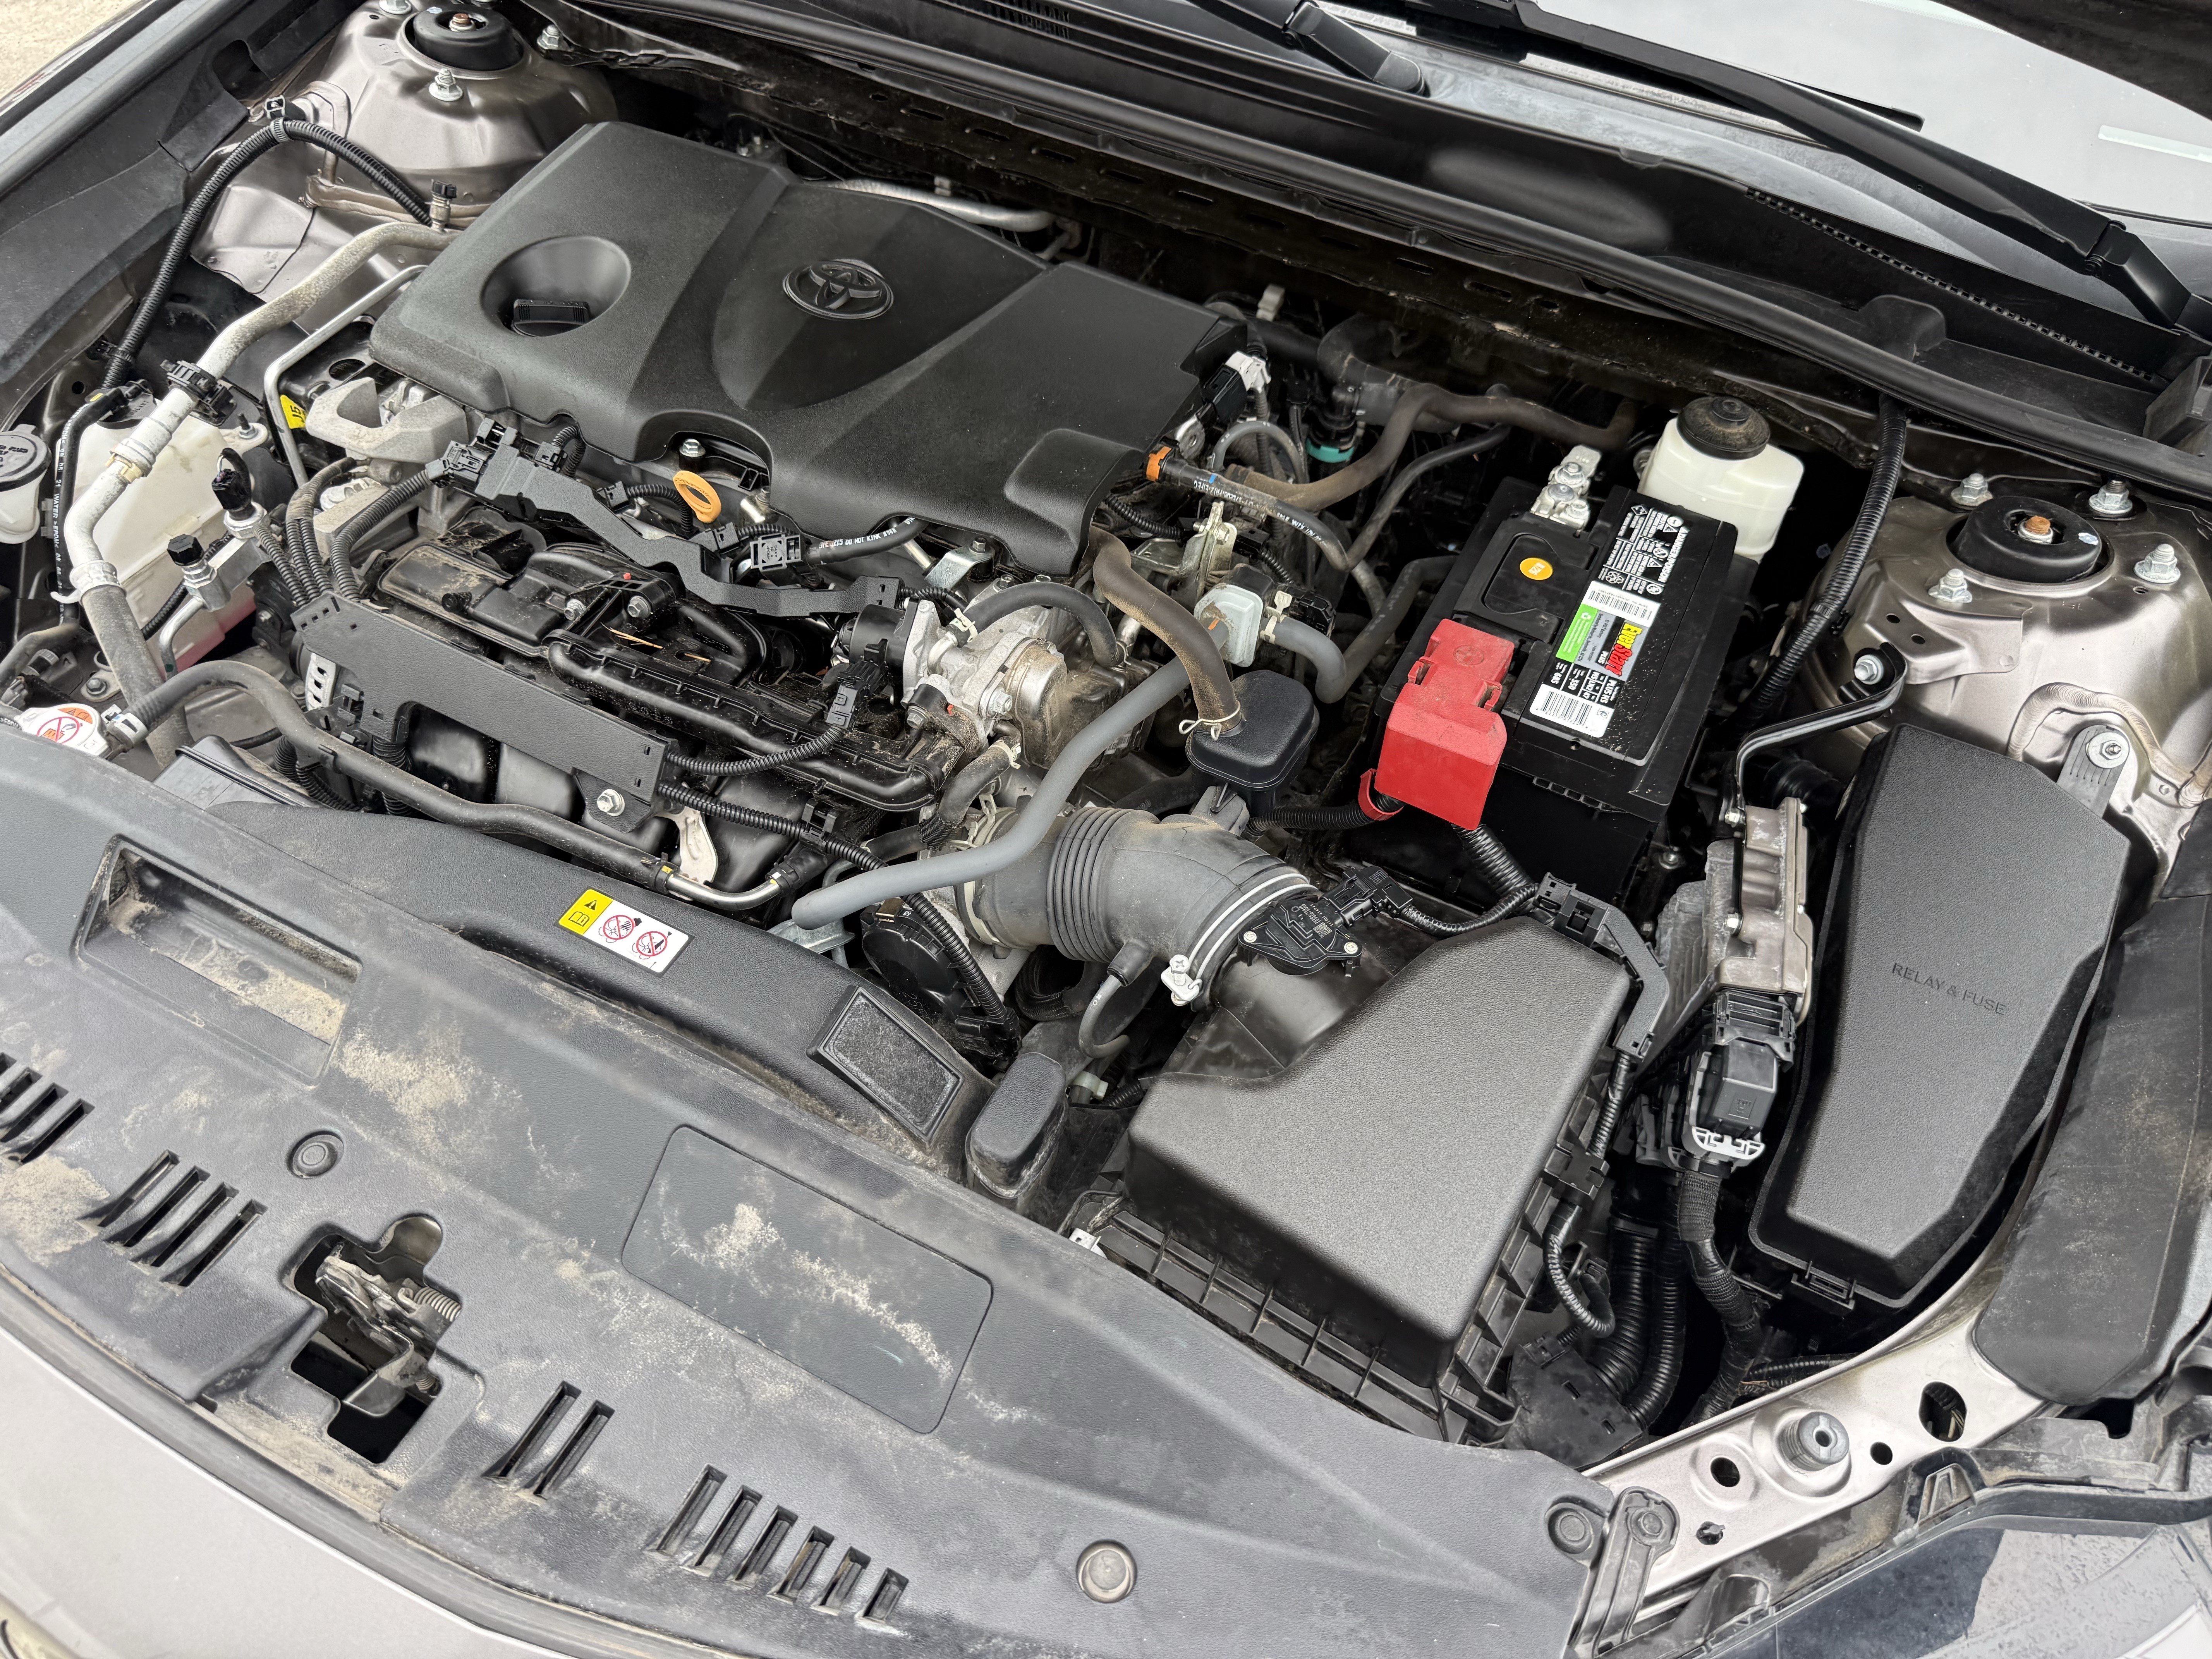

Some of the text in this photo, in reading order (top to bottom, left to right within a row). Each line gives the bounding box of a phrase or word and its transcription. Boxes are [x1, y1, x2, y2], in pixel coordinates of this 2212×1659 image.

[1657, 532, 1686, 584] DANGER/POISON
[1598, 651, 1608, 664] PLUS
[1604, 622, 1643, 677] EverStart
[1604, 680, 1617, 694] PLUS
[1891, 962, 2006, 1015] RELAY & FUSE
